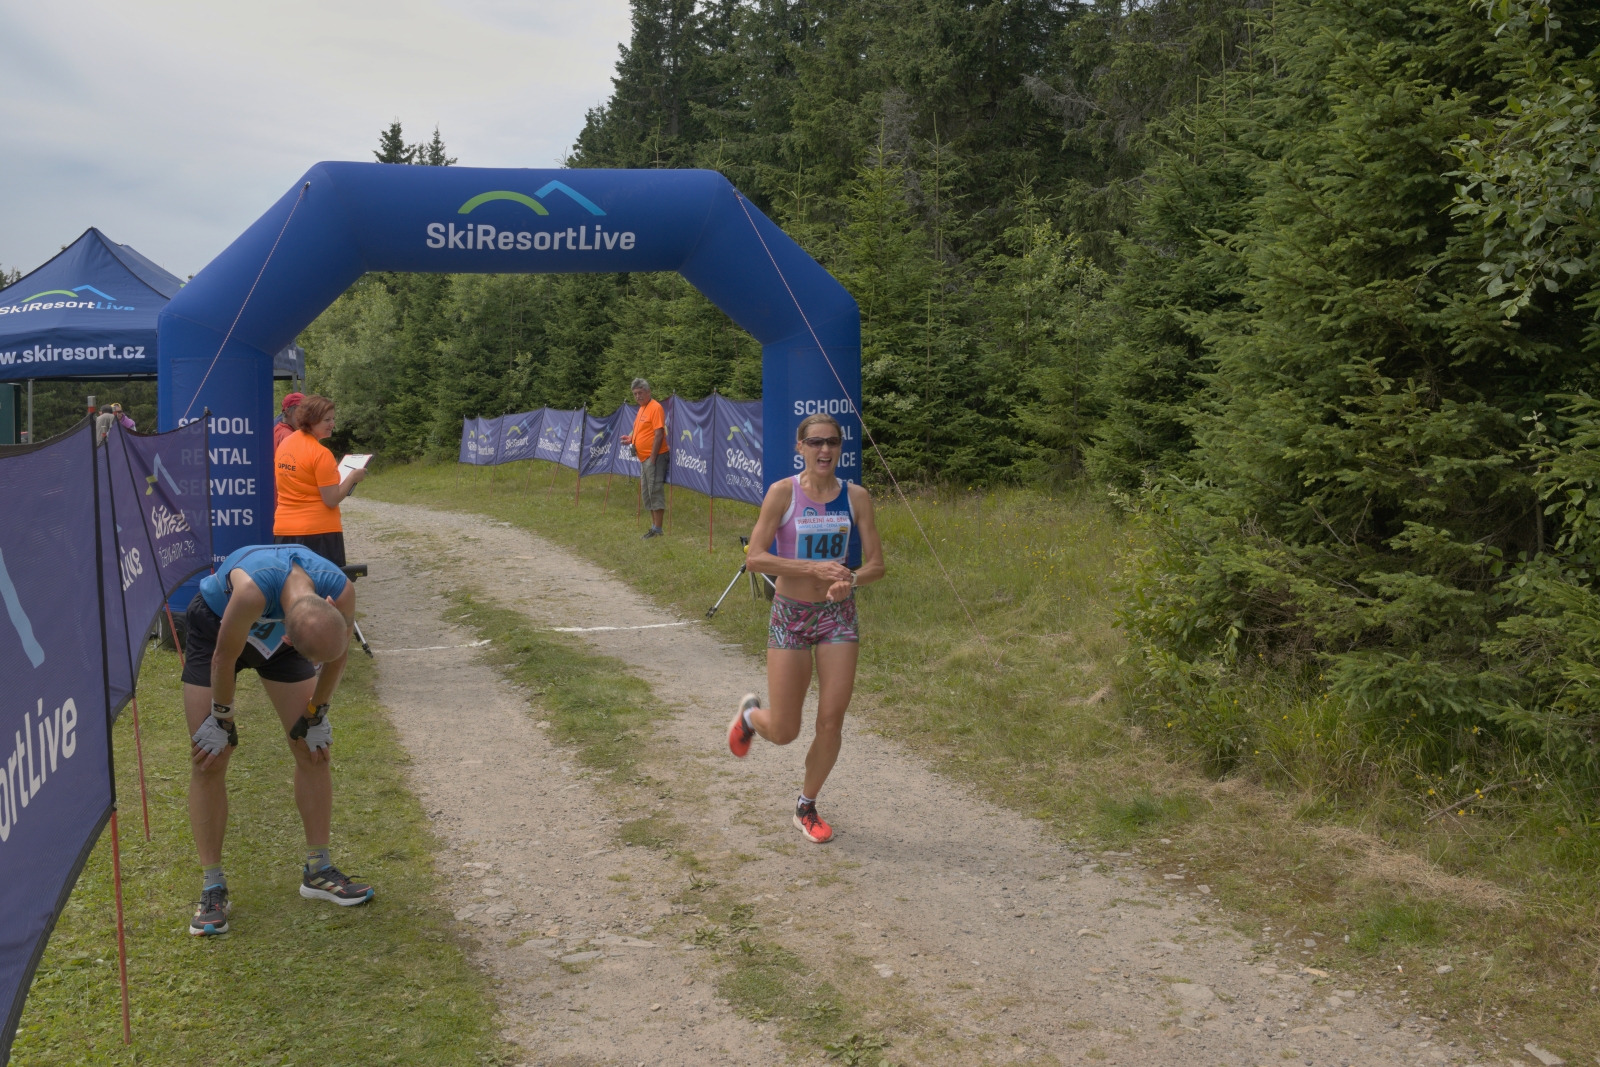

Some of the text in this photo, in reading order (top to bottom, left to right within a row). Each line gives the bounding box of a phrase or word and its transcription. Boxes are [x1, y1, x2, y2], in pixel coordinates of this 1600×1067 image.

[426, 222, 636, 250] SkiResortLive
[0, 301, 135, 315] SkiResortLive
[794, 399, 854, 415] SCHOOL
[178, 417, 254, 435] SCHOOL
[181, 448, 252, 465] RENTAL
[179, 478, 256, 495] SERVICE
[805, 534, 844, 559] 148
